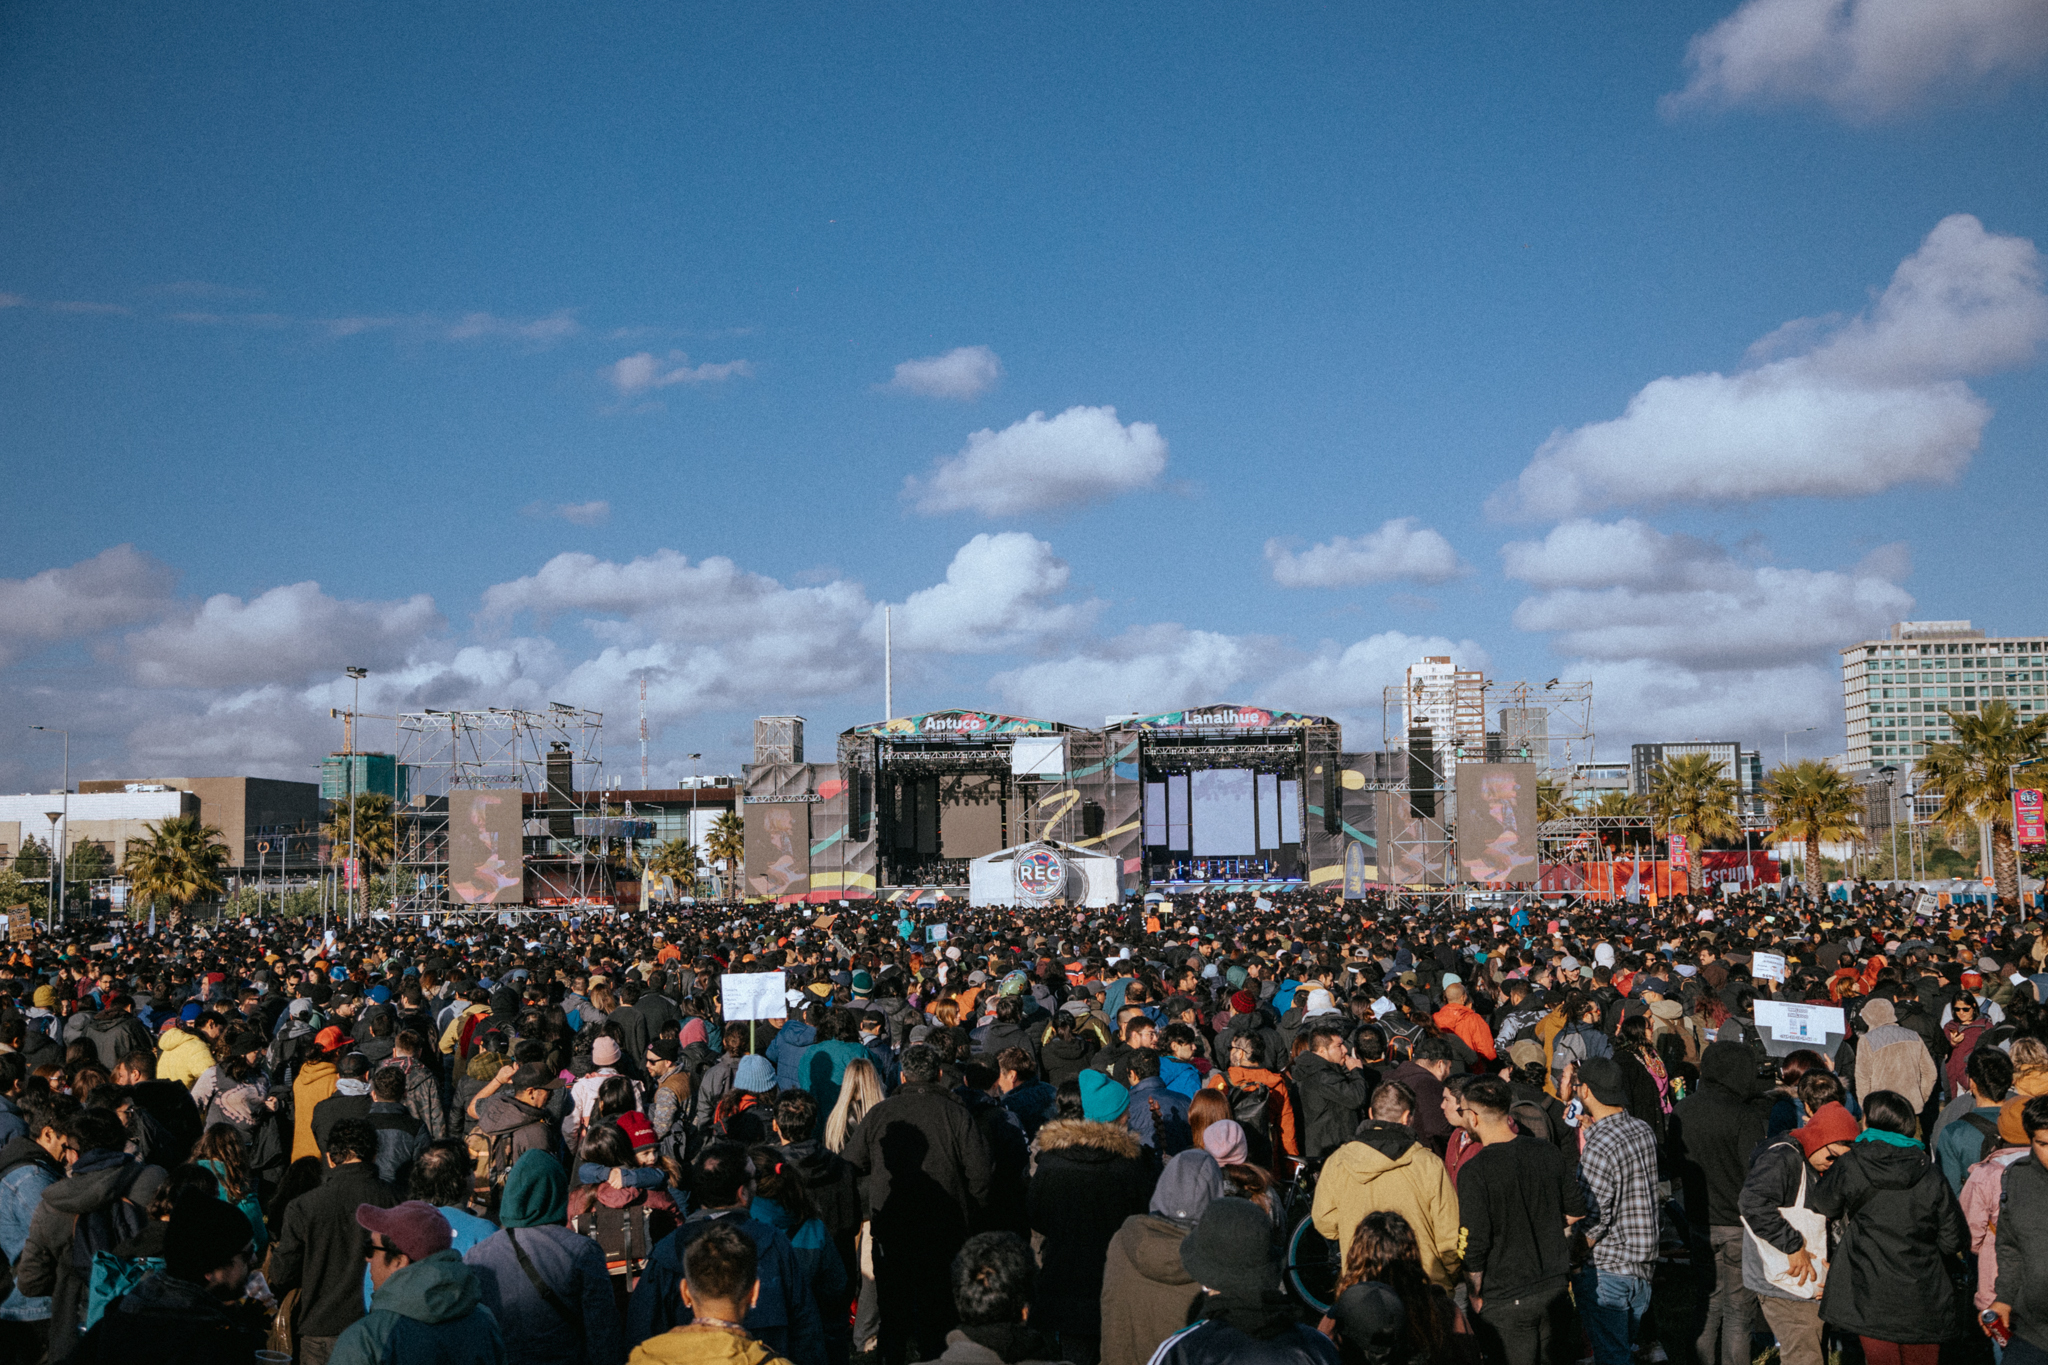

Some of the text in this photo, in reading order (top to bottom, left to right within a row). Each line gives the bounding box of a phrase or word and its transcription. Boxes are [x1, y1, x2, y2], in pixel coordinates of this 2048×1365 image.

[924, 717, 980, 730] Antuco
[1184, 710, 1259, 725] Lanalhue
[1020, 865, 1060, 881] REC
